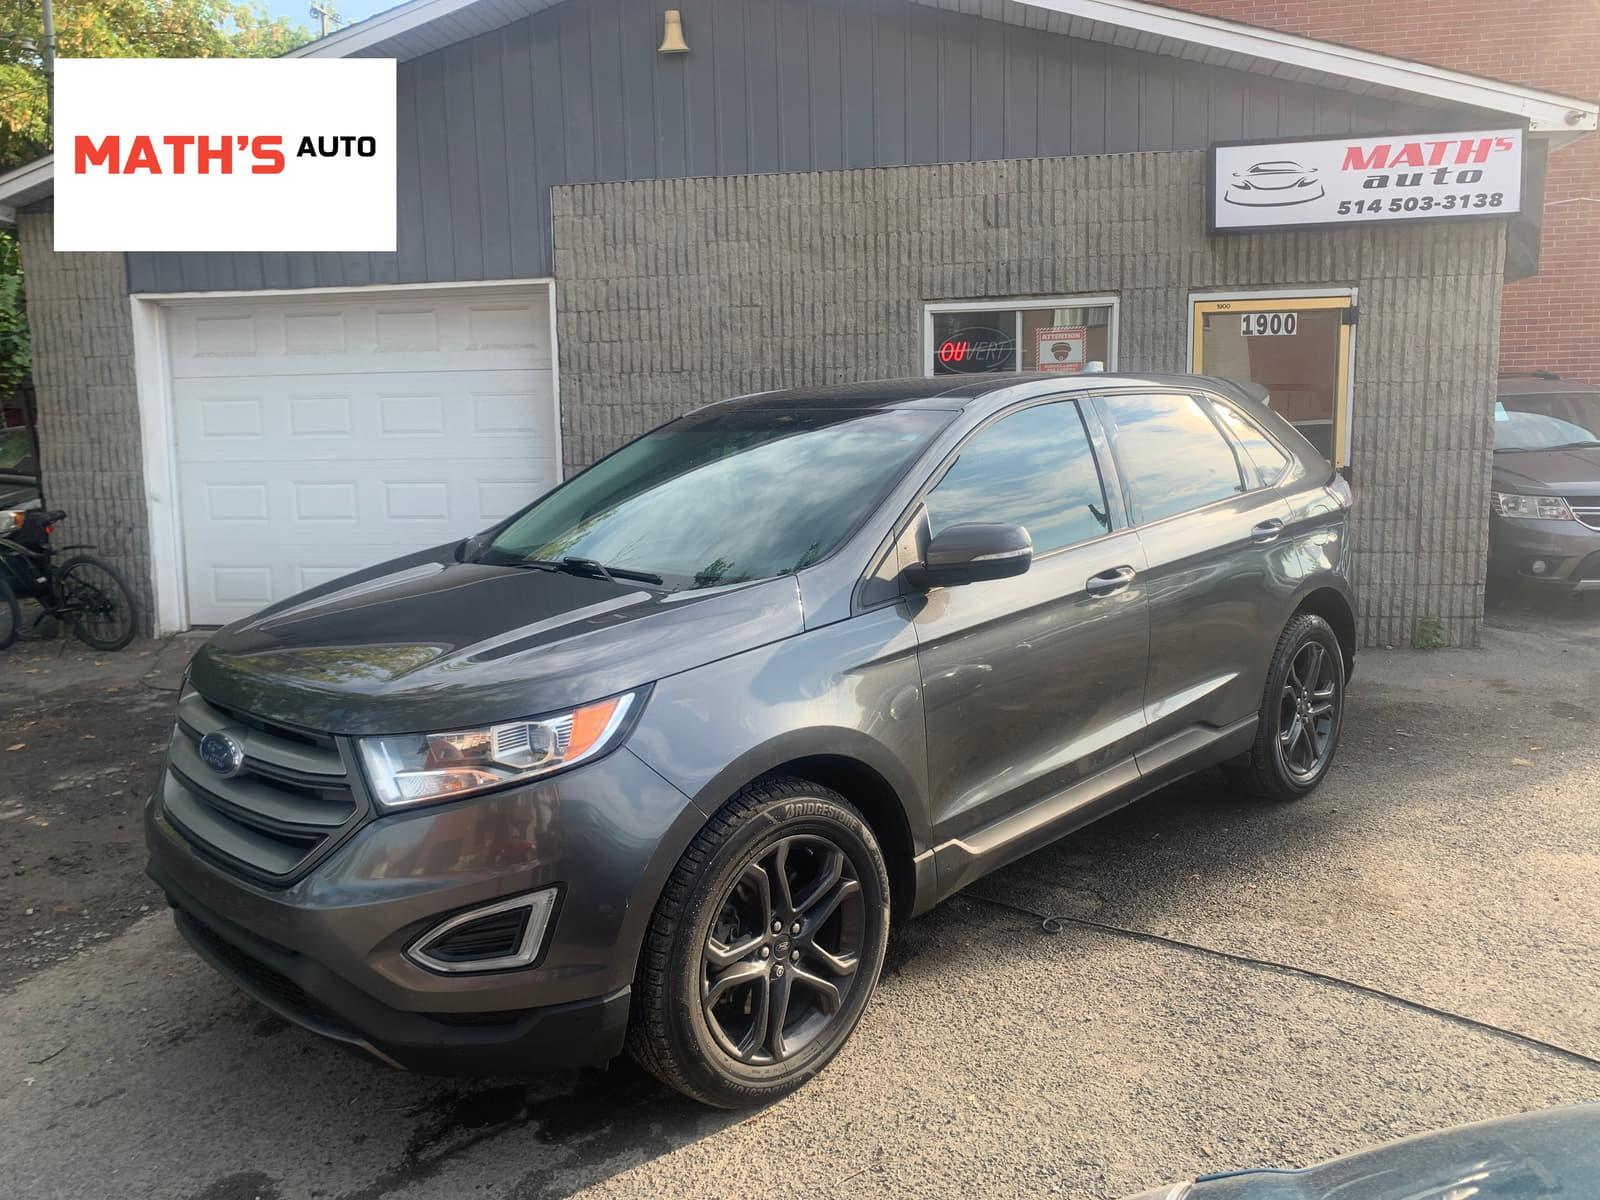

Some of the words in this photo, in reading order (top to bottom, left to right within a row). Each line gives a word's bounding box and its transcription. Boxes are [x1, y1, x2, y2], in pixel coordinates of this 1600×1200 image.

[1362, 167, 1483, 189] auto
[1337, 199, 1383, 215] 514
[1388, 193, 1504, 212] 503-3138
[1242, 314, 1296, 335] 1900
[1042, 332, 1081, 340] ATTENTION
[941, 341, 1009, 361] OUVERT
[785, 803, 858, 831] BRIDGESTONE
